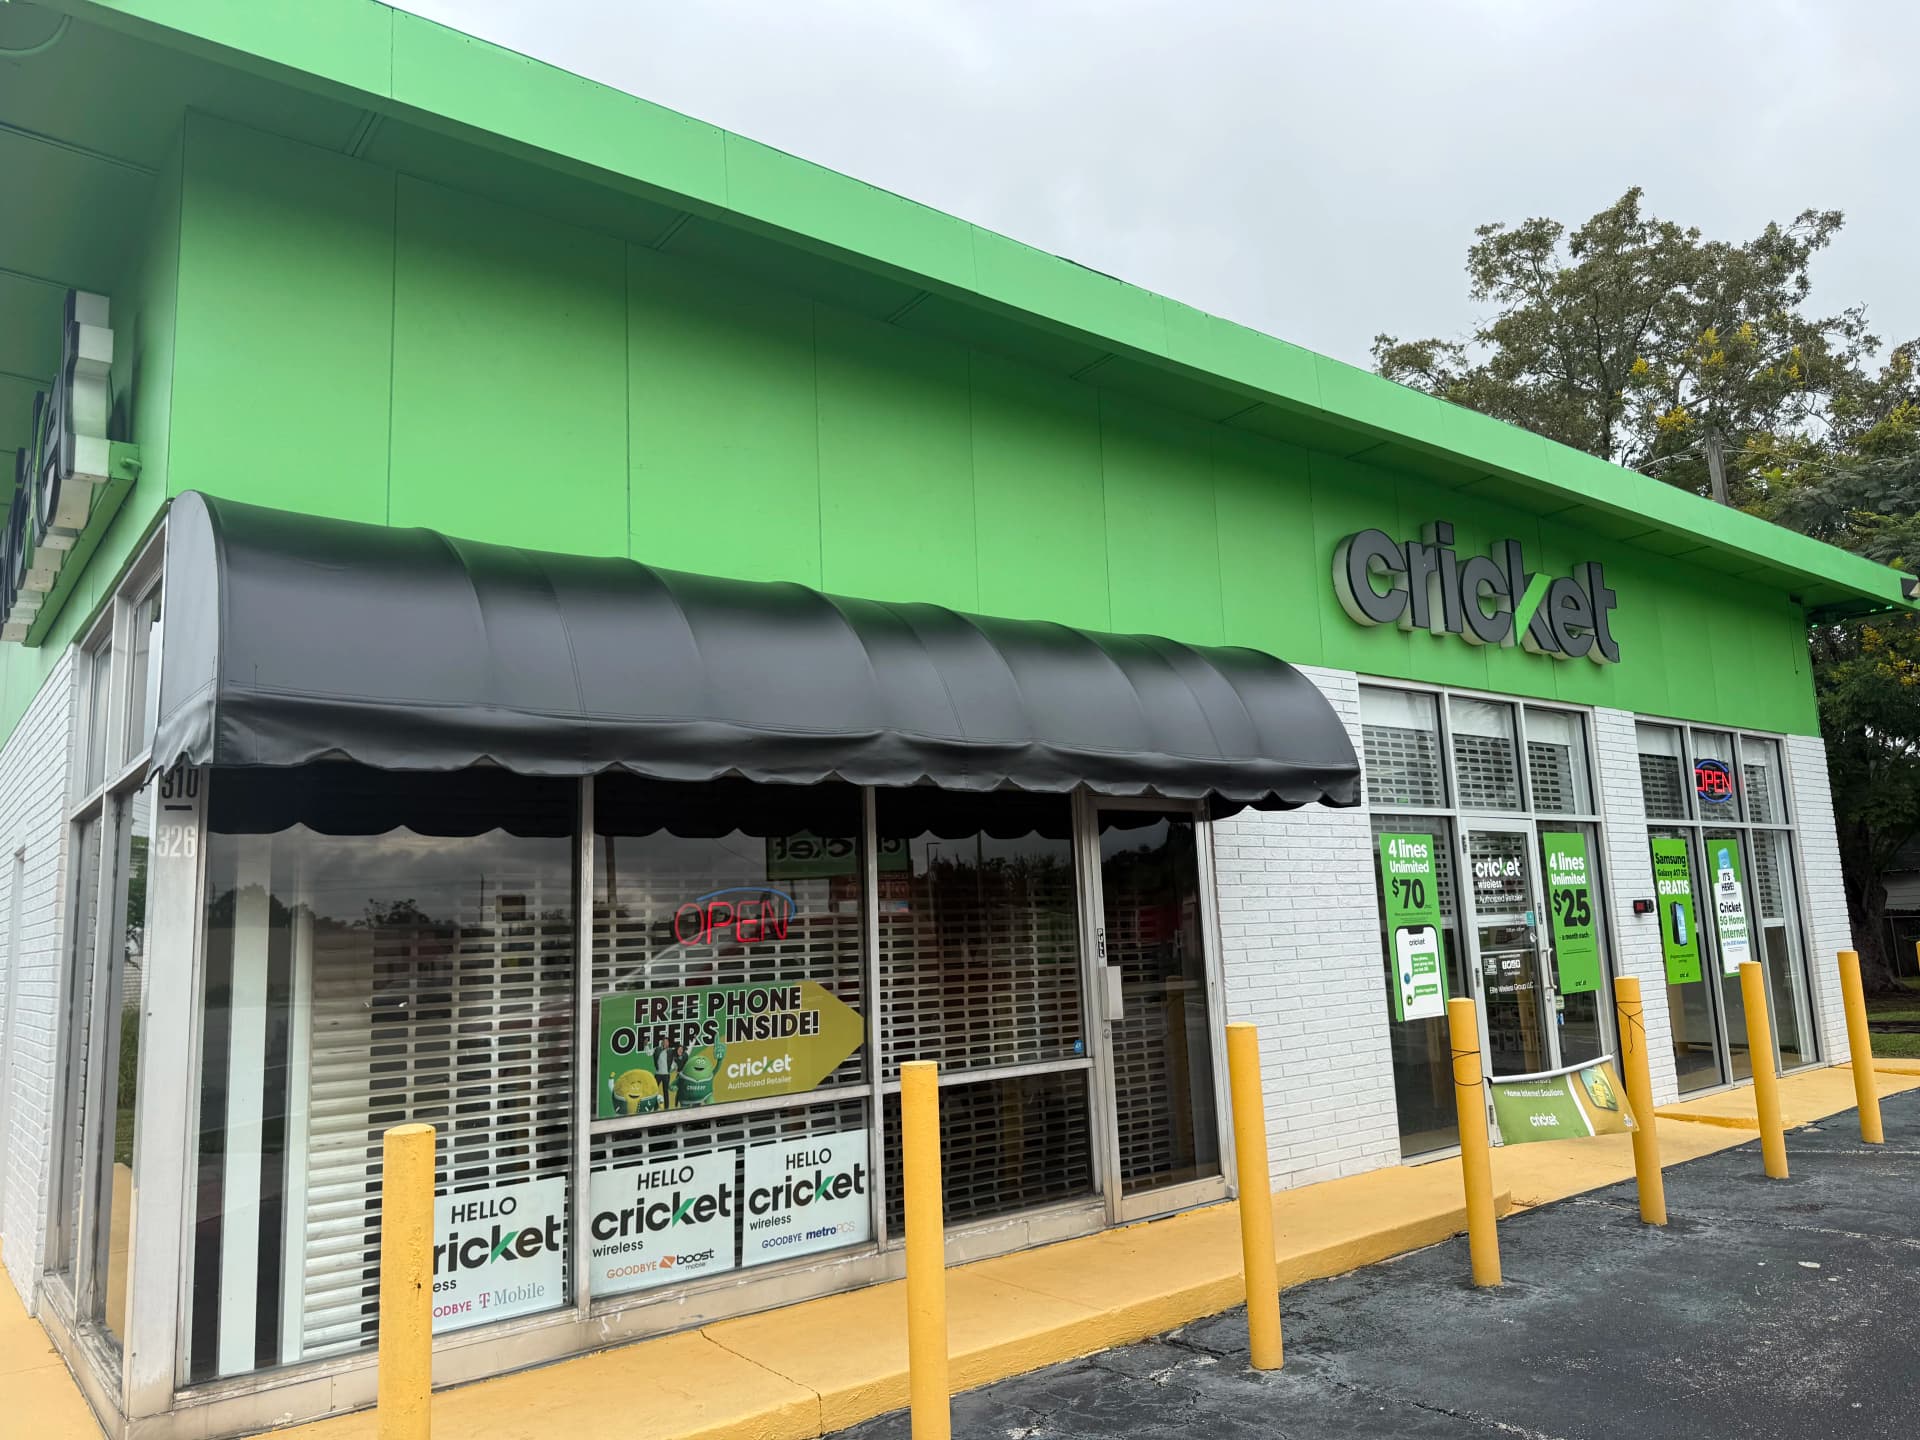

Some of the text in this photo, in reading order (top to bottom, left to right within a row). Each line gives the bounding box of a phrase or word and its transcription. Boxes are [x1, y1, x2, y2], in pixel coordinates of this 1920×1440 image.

[1332, 520, 1620, 664] cricket
[161, 766, 199, 799] 310
[1694, 768, 1732, 793] OPEN
[156, 824, 196, 858] 326
[1388, 839, 1428, 858] 4 lines
[1389, 860, 1430, 873] Unlimited
[1475, 857, 1521, 878] cricket
[1549, 852, 1584, 870] 4 lines
[1655, 853, 1686, 867] Samsung
[1477, 879, 1503, 889] wireless
[1551, 873, 1586, 885] Unlimited
[1658, 880, 1690, 895] GRATIS
[1392, 876, 1425, 909] $70
[1553, 888, 1591, 927] $25
[1720, 901, 1742, 913] Cricket
[674, 899, 788, 945] OPEN
[1728, 915, 1745, 925] Home
[1721, 927, 1747, 940] Internet
[634, 986, 802, 1025] FREE PHONE
[610, 1010, 820, 1056] OFFERS INSIDE!
[727, 1053, 791, 1079] cricket
[727, 1076, 792, 1090] Authorized Retailer
[1529, 1112, 1560, 1127] cricket
[786, 1148, 832, 1170] HELLO
[637, 1165, 694, 1191] HELLO
[748, 1163, 865, 1215] cricket
[451, 1196, 517, 1225] HELLO
[591, 1183, 732, 1241] cricket
[749, 1214, 792, 1231] wireless
[433, 1214, 561, 1276] ricket
[592, 1240, 644, 1258] wireless
[762, 1233, 802, 1249] GOODBYE
[607, 1248, 715, 1279] GOODBYE boost
[433, 1300, 472, 1318] ODBYE
[493, 1282, 545, 1306] Mobile
